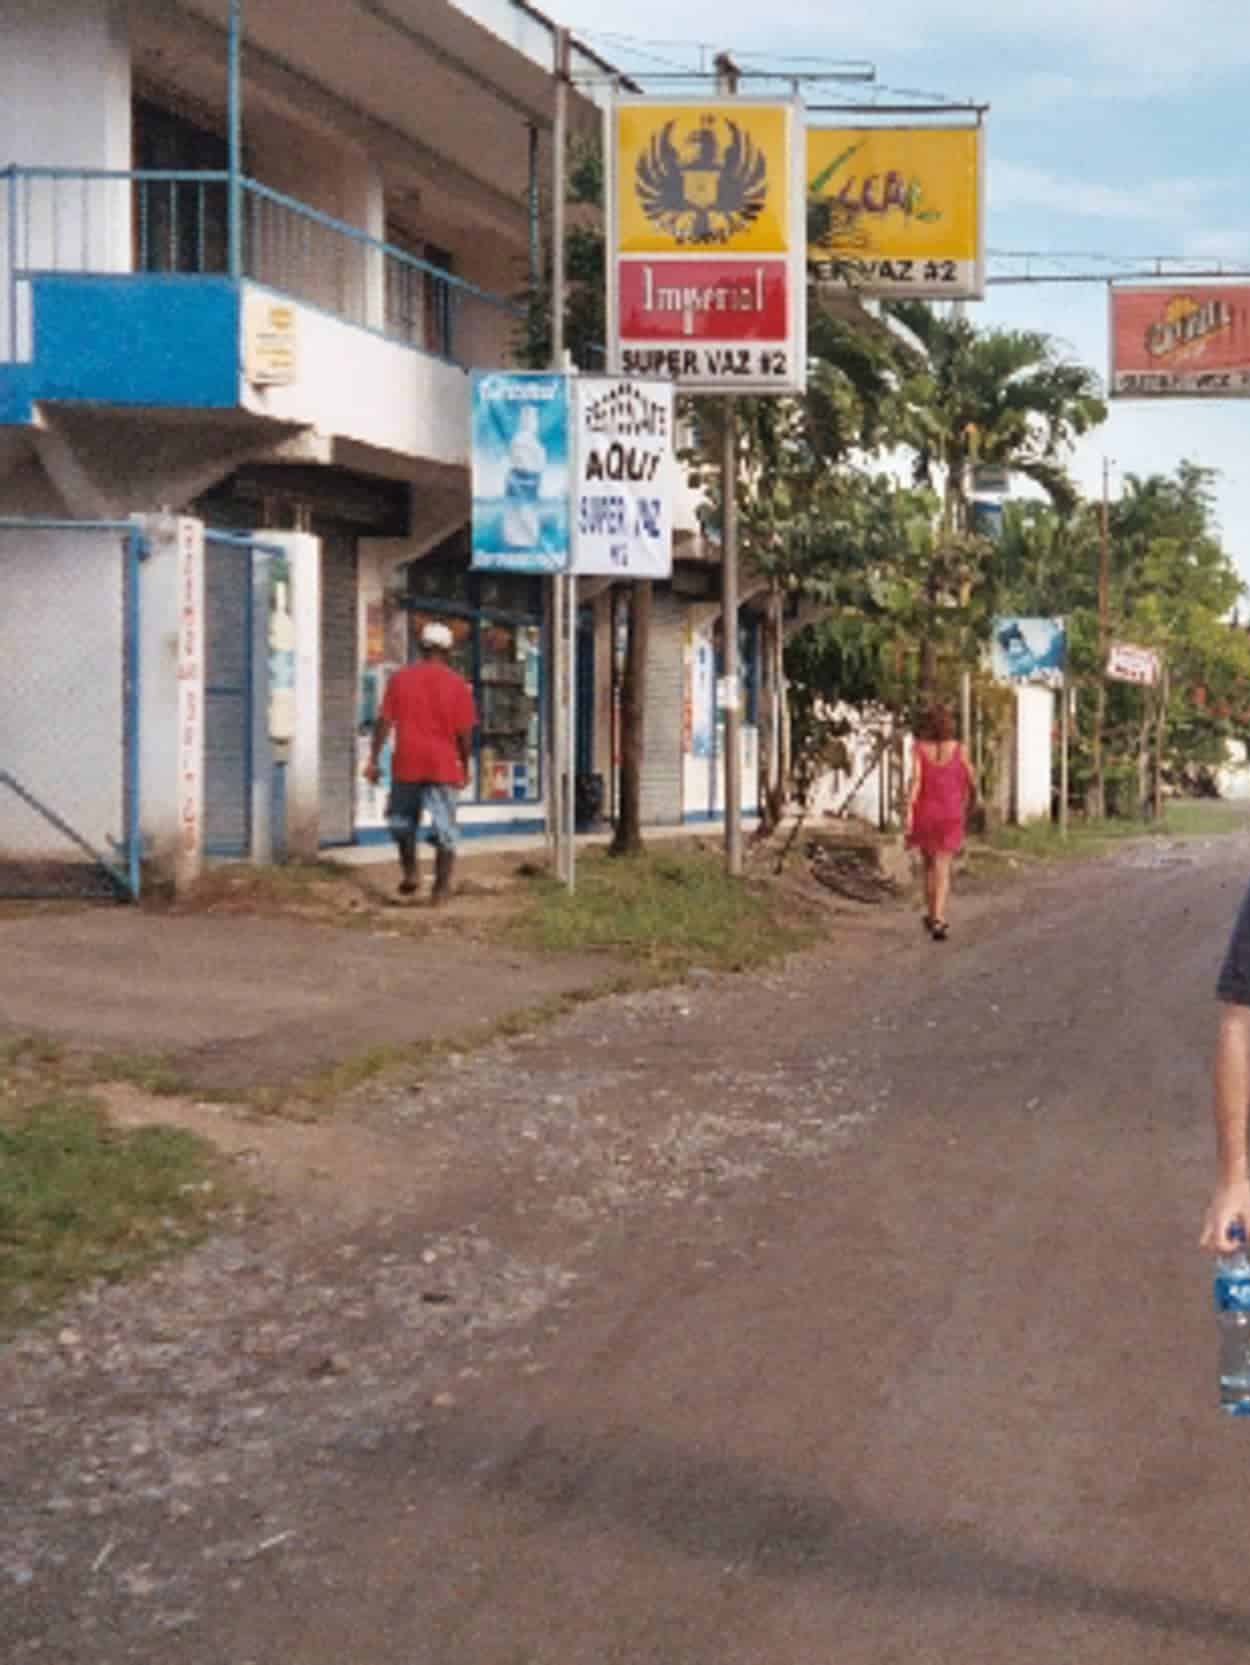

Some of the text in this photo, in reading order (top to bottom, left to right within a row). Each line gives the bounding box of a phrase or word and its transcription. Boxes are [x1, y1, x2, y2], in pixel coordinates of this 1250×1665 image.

[923, 260, 958, 282] #2
[643, 264, 764, 336] Imperial
[622, 348, 788, 376] SUPER VAZ #2
